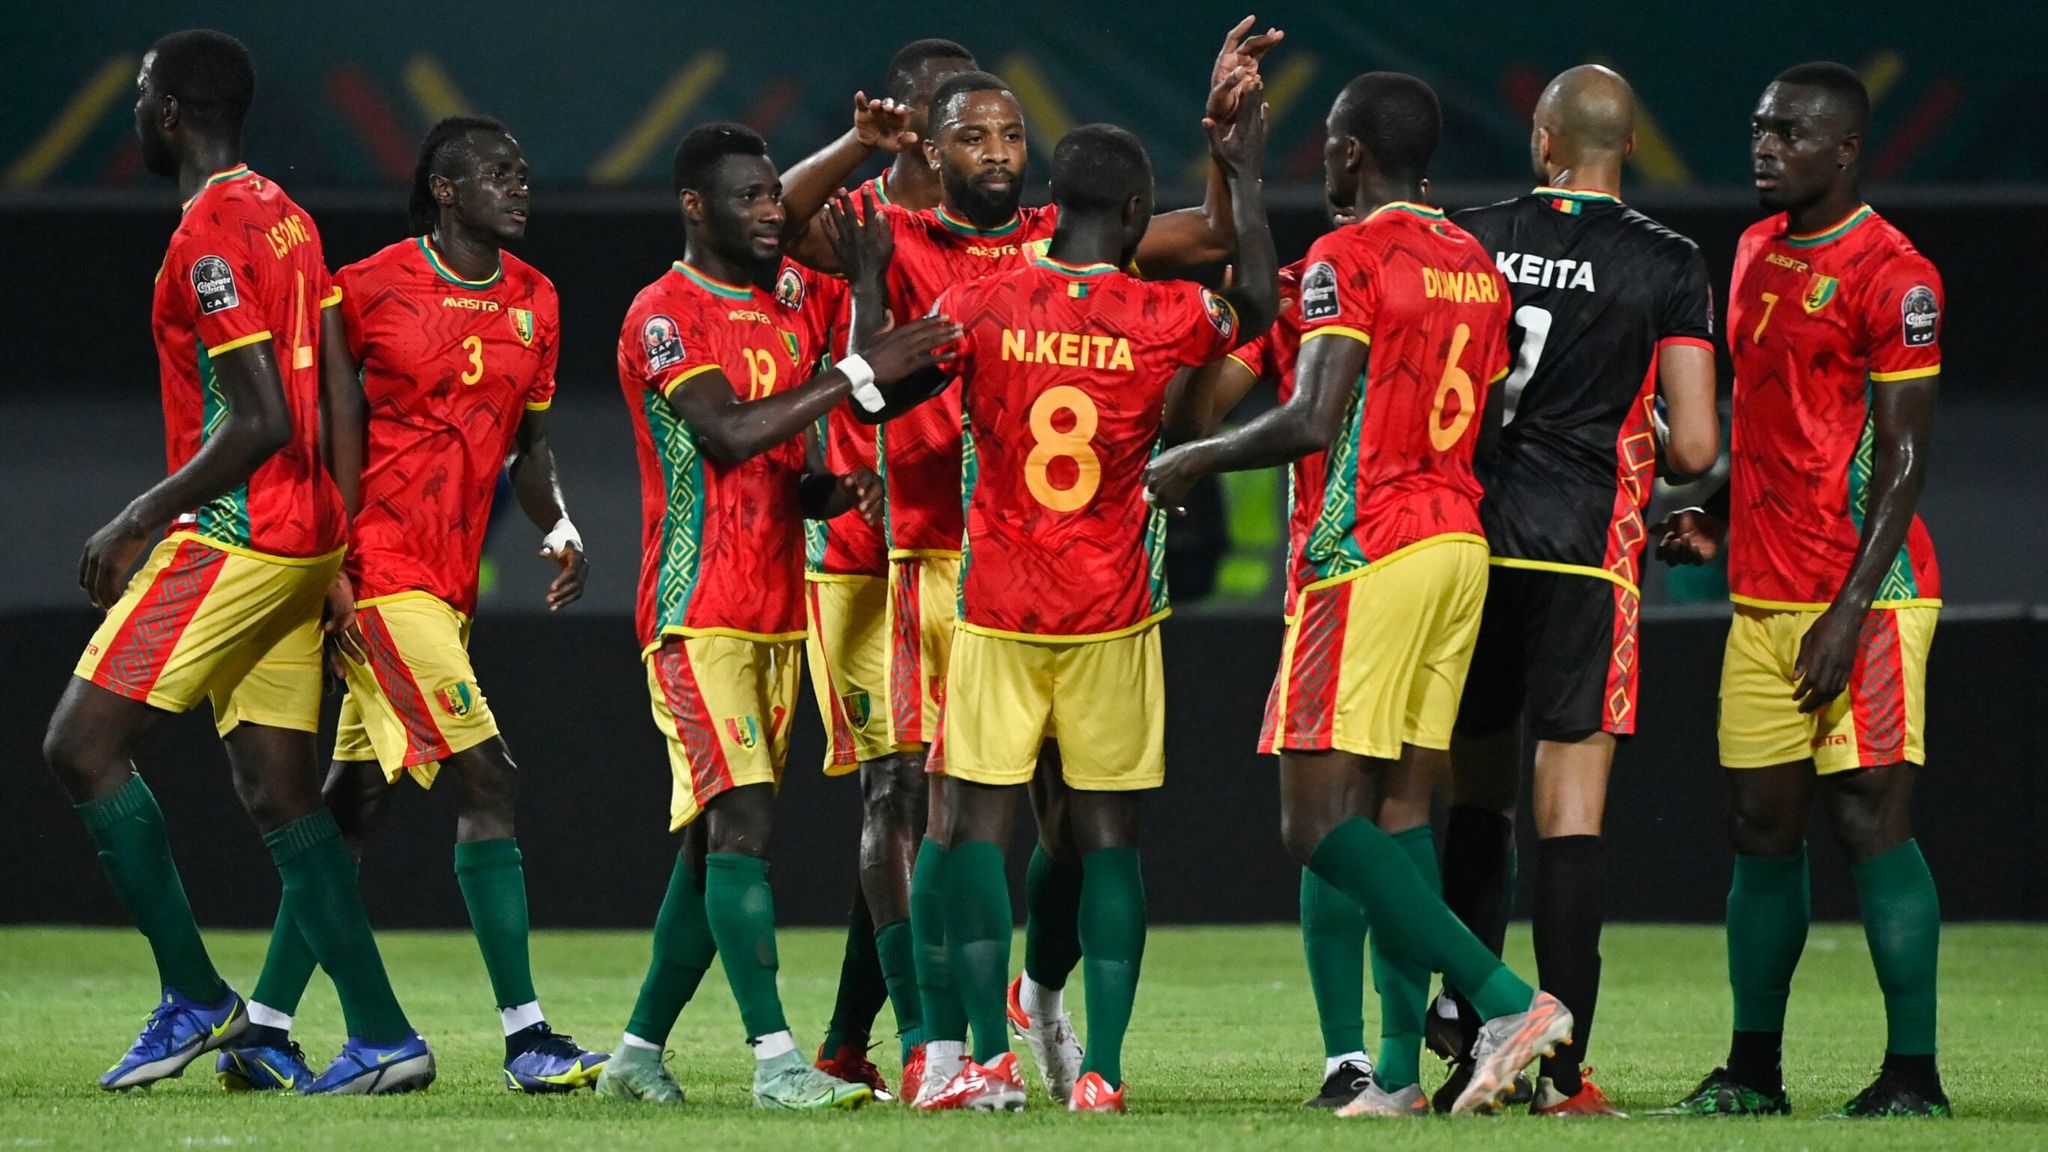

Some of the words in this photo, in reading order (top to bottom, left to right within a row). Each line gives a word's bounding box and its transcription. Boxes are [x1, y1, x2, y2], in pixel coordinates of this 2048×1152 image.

[1496, 252, 1595, 292] KEITA
[1753, 292, 1779, 344] 7
[462, 335, 484, 385] 3
[743, 348, 777, 400] 19
[1001, 329, 1136, 371] N.KEITA
[1429, 322, 1475, 451] 6
[1024, 385, 1101, 512] 8
